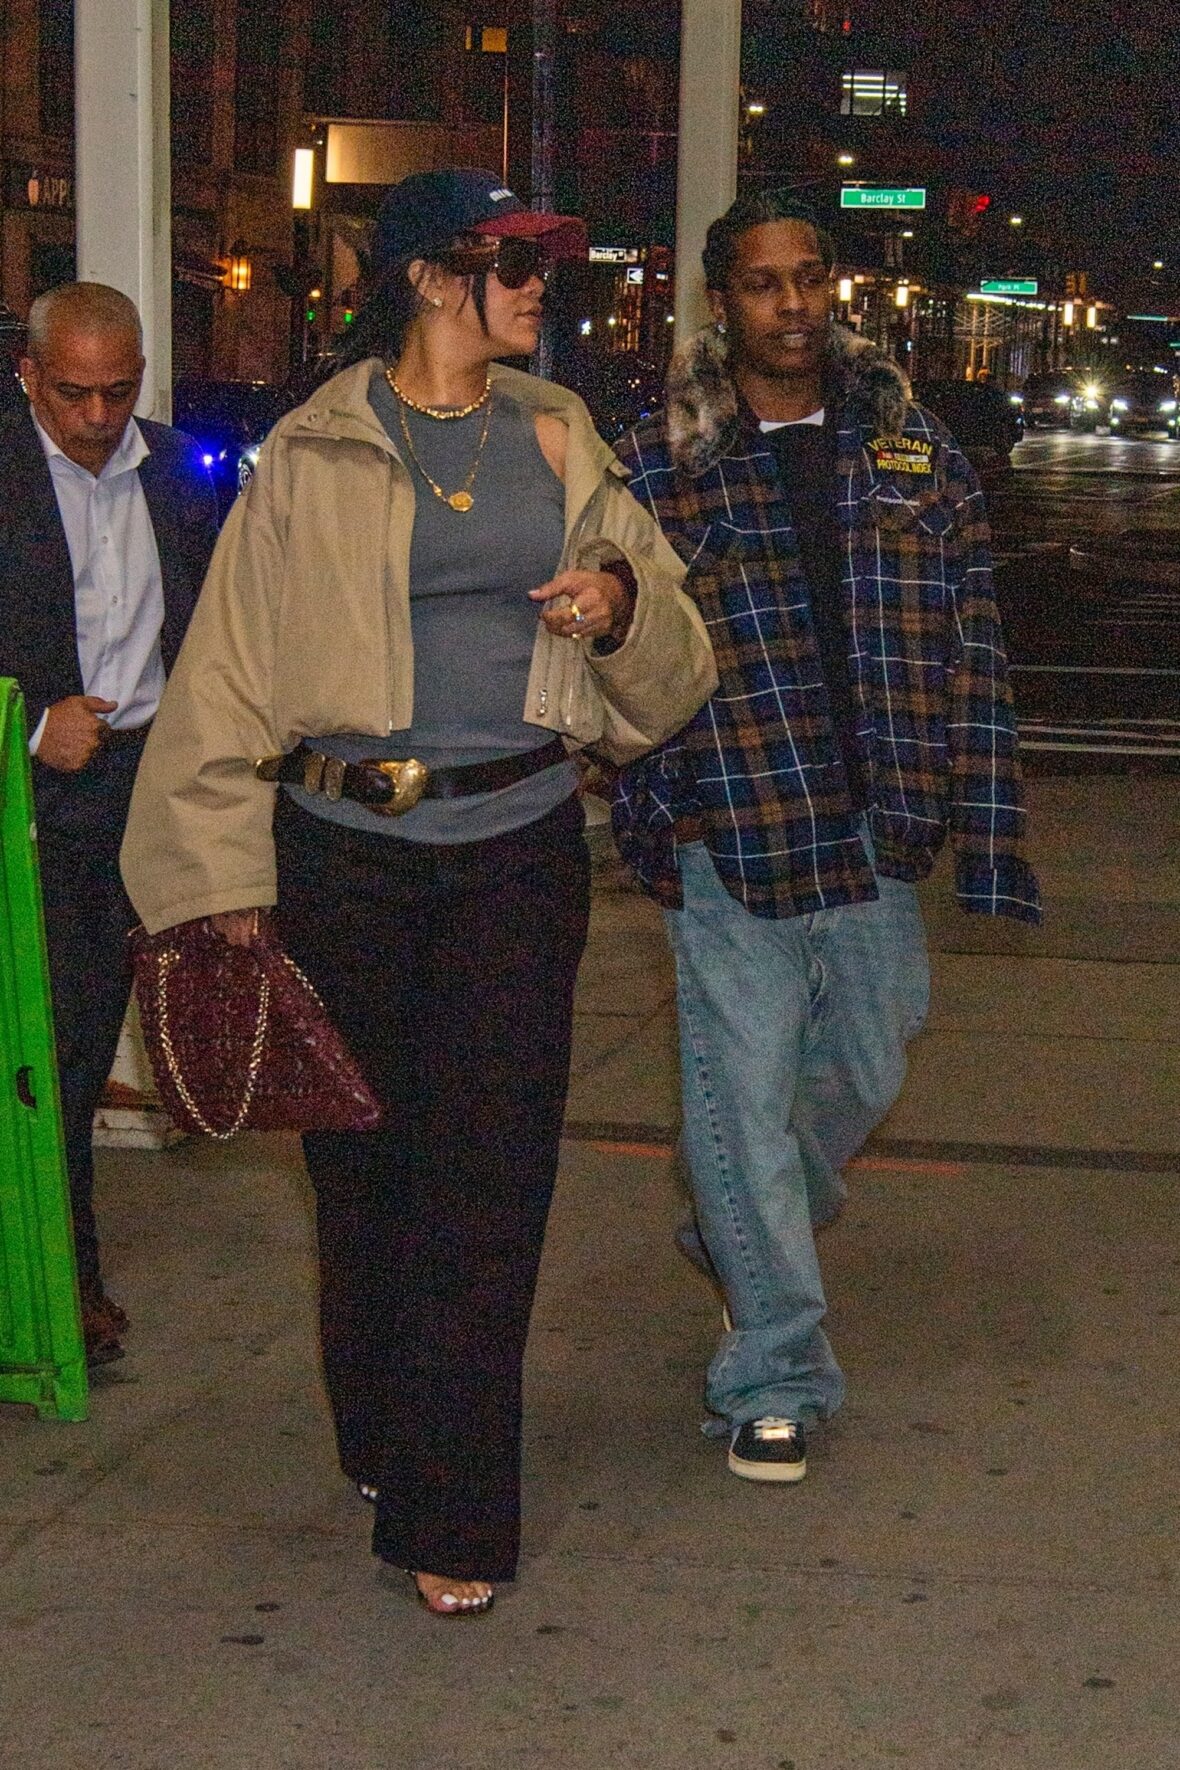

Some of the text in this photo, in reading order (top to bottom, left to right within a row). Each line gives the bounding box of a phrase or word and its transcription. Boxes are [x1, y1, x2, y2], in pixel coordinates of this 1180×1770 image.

[860, 193, 906, 205] Barclay St
[867, 438, 933, 456] VETERAN
